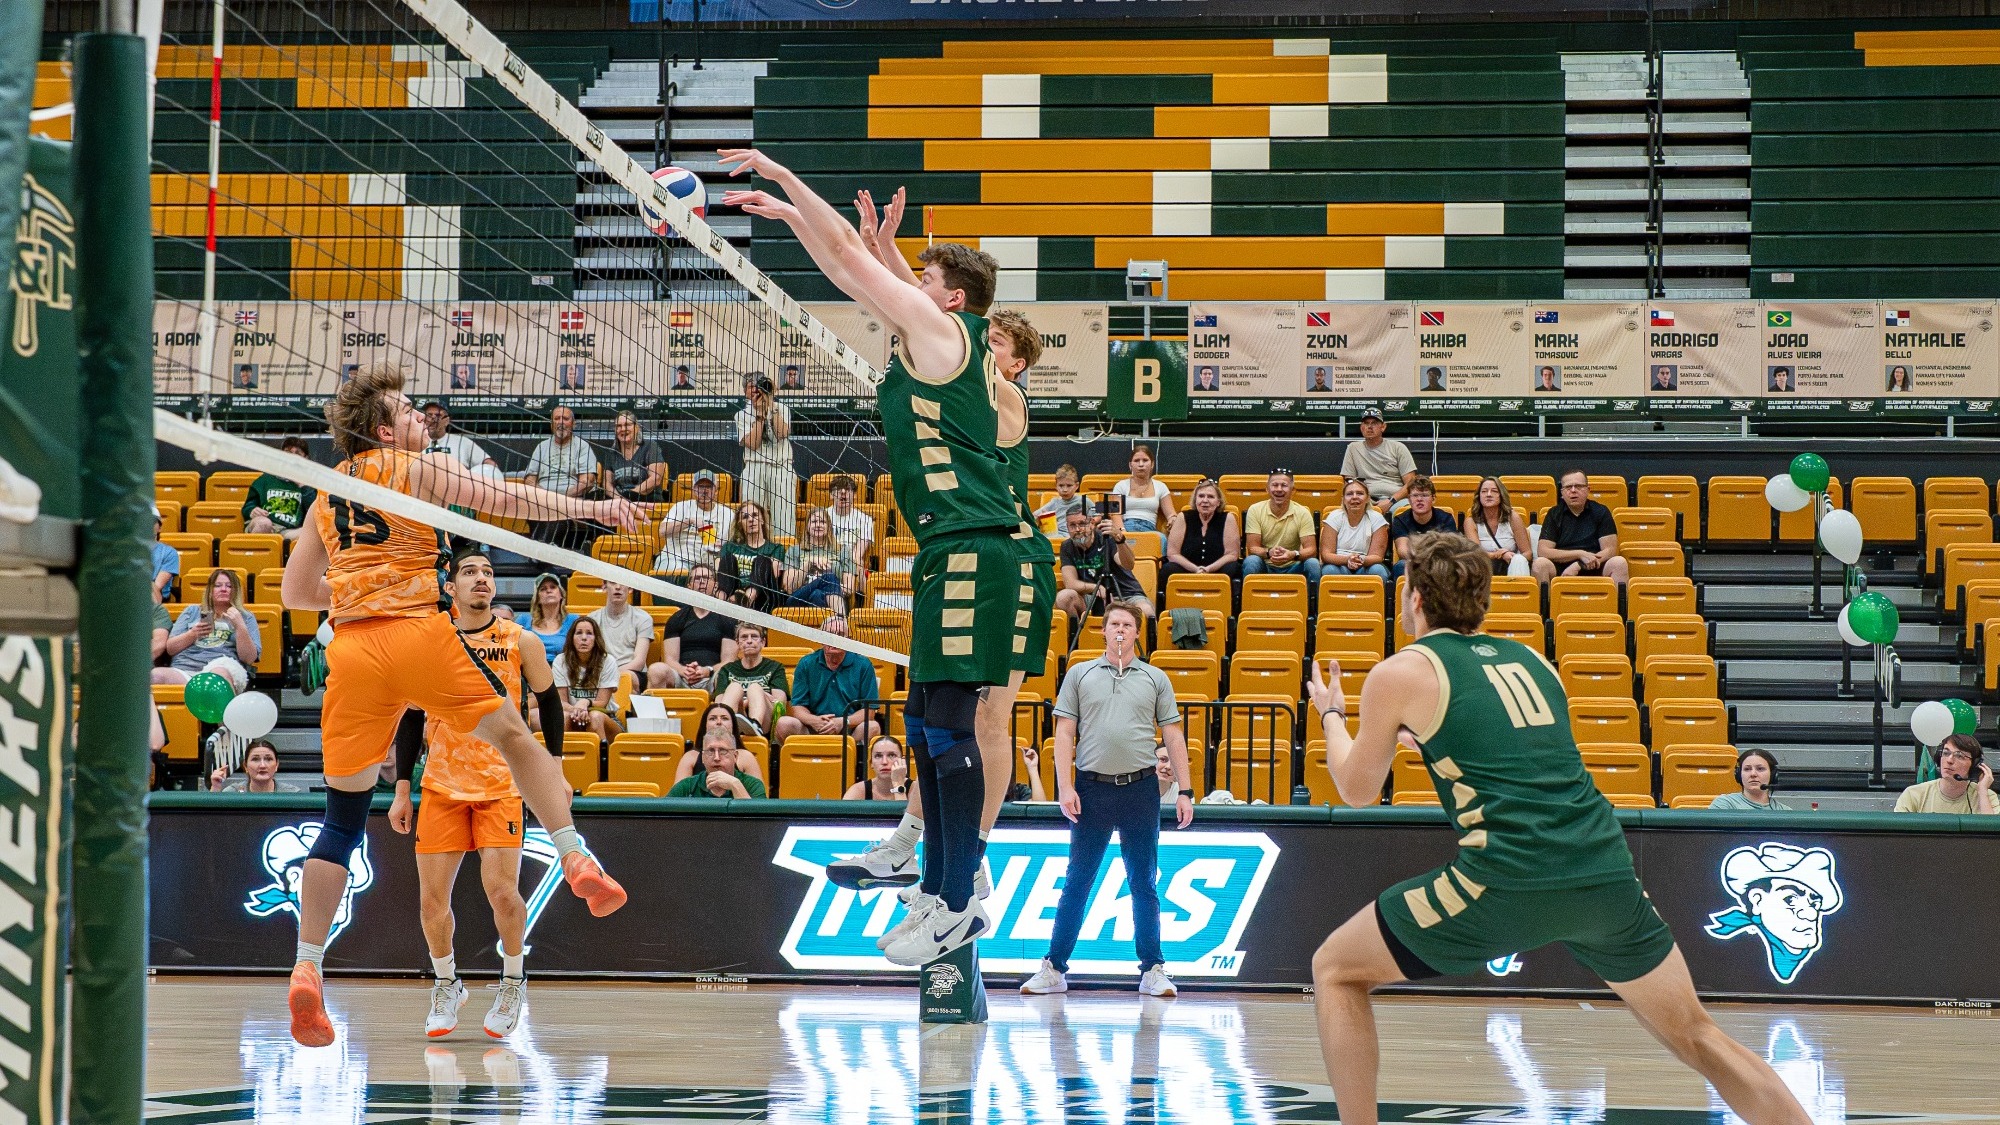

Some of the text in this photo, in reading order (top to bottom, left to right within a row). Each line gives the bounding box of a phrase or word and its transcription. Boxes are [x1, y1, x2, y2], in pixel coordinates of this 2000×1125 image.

[234, 333, 275, 346] ANDY
[343, 333, 386, 346] ISAAC
[452, 334, 505, 347] JULIAN
[560, 334, 596, 347] MIKE
[670, 334, 704, 347] IKER
[1193, 334, 1230, 348] LIAM
[1306, 335, 1348, 348] ZYON
[1420, 334, 1466, 348] KHIBA
[1534, 334, 1578, 347] MARK
[1650, 333, 1718, 347] RODRIGO
[1767, 334, 1808, 347] JOAO
[1885, 333, 1965, 347] NATHALIE
[1134, 358, 1160, 402] B
[329, 494, 390, 550] 15
[1482, 662, 1556, 729] 10
[817, 853, 1237, 942] MNERS
[1211, 956, 1236, 969] TM
